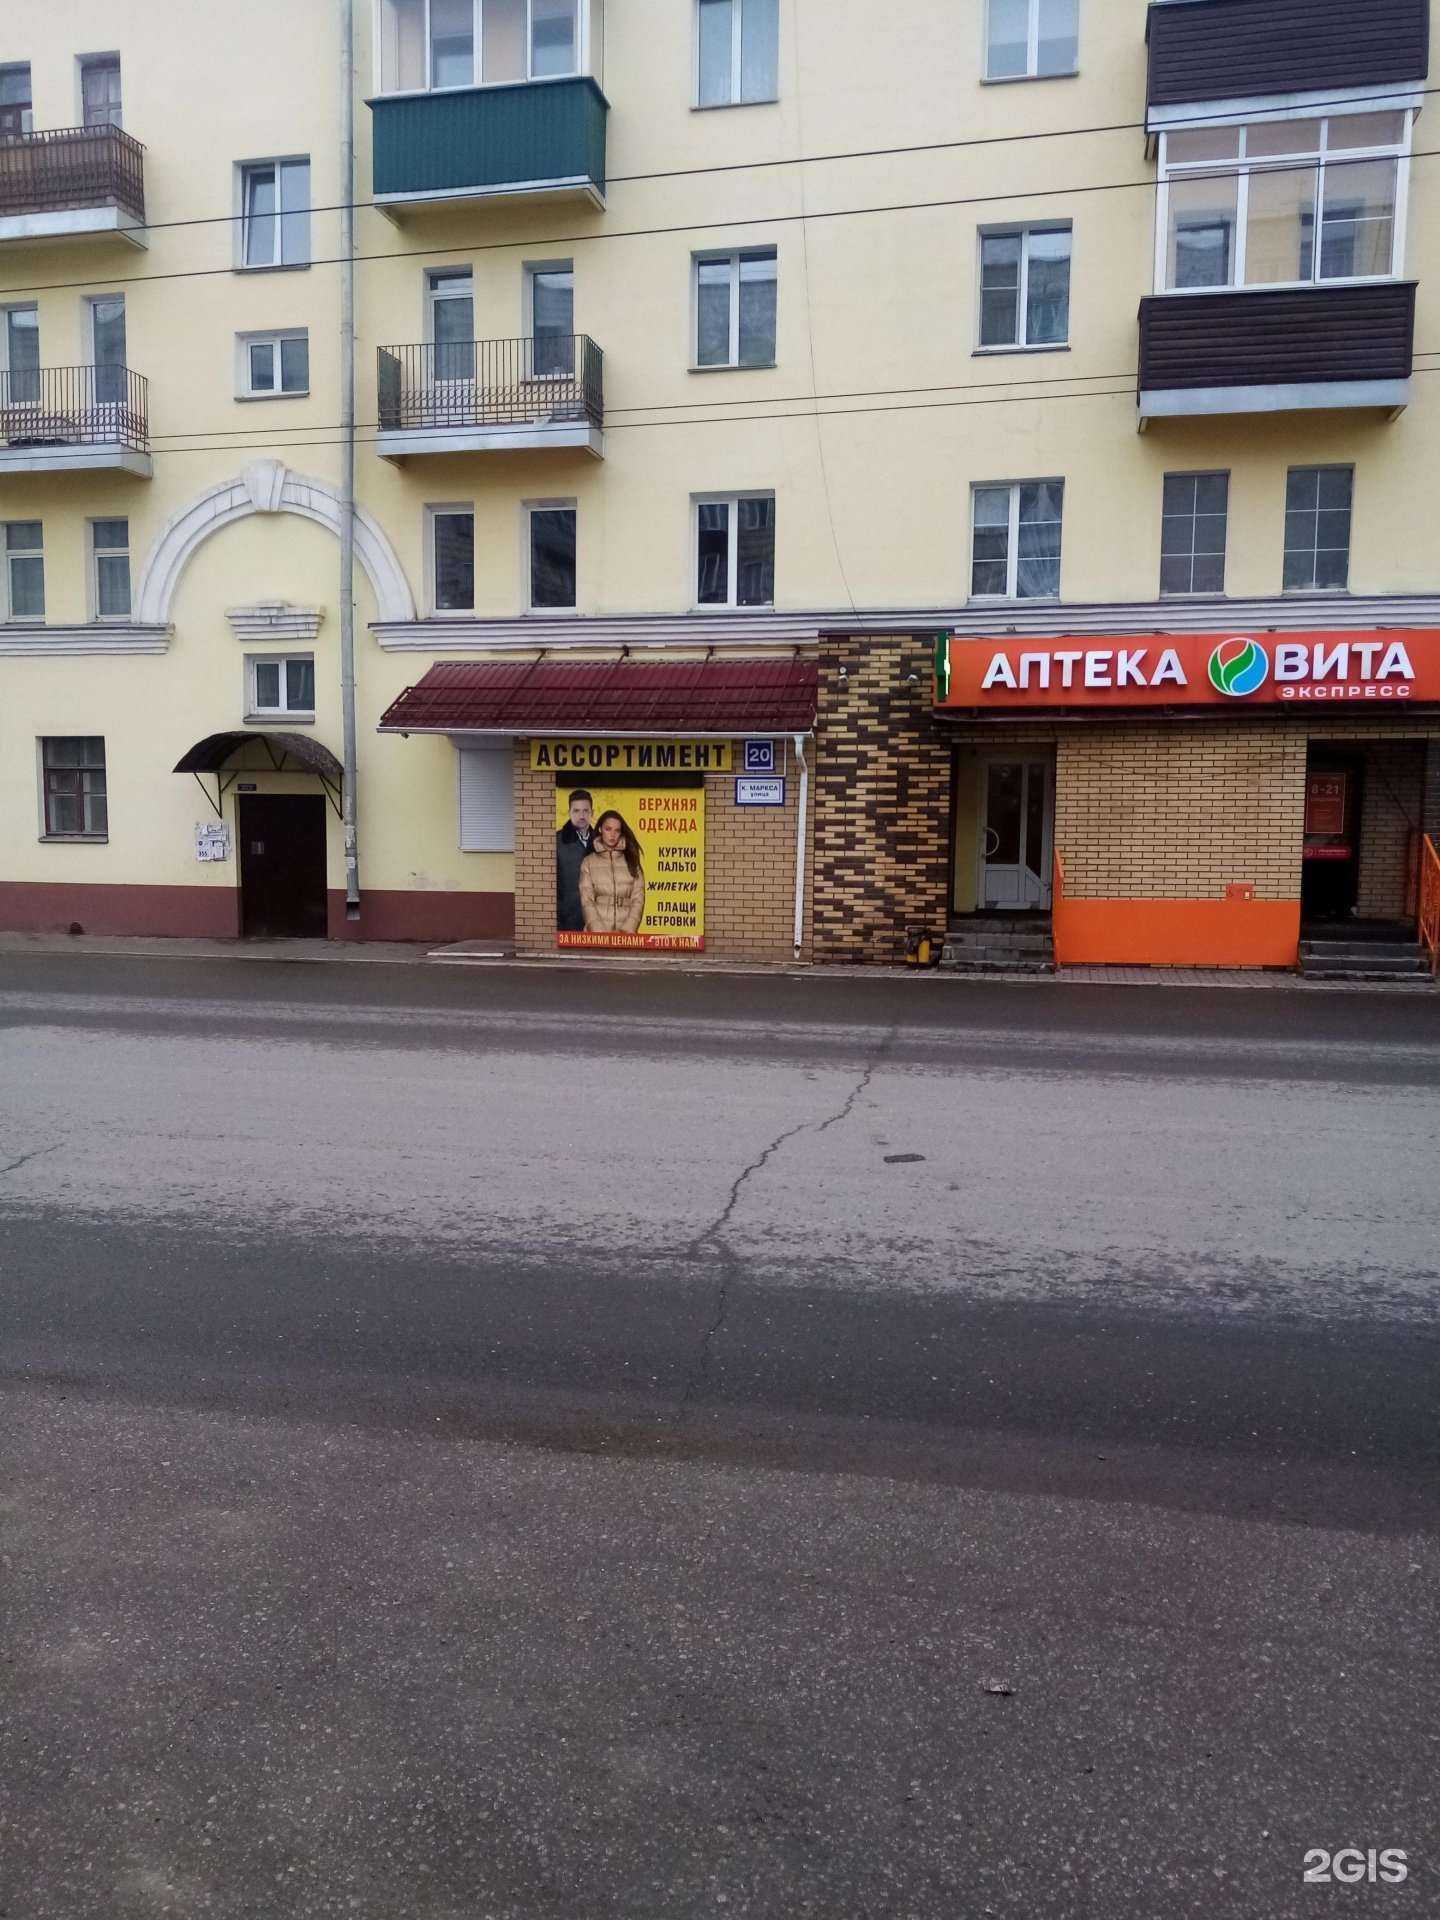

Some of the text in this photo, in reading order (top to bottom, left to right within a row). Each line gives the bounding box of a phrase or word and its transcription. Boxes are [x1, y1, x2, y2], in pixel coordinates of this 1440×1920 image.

[1274, 642, 1416, 681] ВИТА
[981, 649, 1188, 689] АПТЕКА
[1282, 685, 1410, 698] ЭКСПРЕСС
[536, 744, 726, 768] АССОРТИМЕНТ
[749, 748, 770, 762] 20
[639, 798, 697, 812] ВЕРХНЯЯ
[639, 817, 697, 833] ОДЕЖДА
[658, 847, 697, 858] КУРТКИ
[657, 861, 697, 872] ПАЛЬТО
[647, 881, 698, 892] ЖИЛЕТКИ
[657, 901, 696, 914] ПЛАЩИ
[646, 916, 696, 927] ВЕТРОВКИ
[559, 934, 569, 944] ЗА
[571, 934, 610, 945] НИЗКИМИ
[611, 935, 645, 946] ЦЕНАМИ
[654, 936, 670, 947] ЭТО
